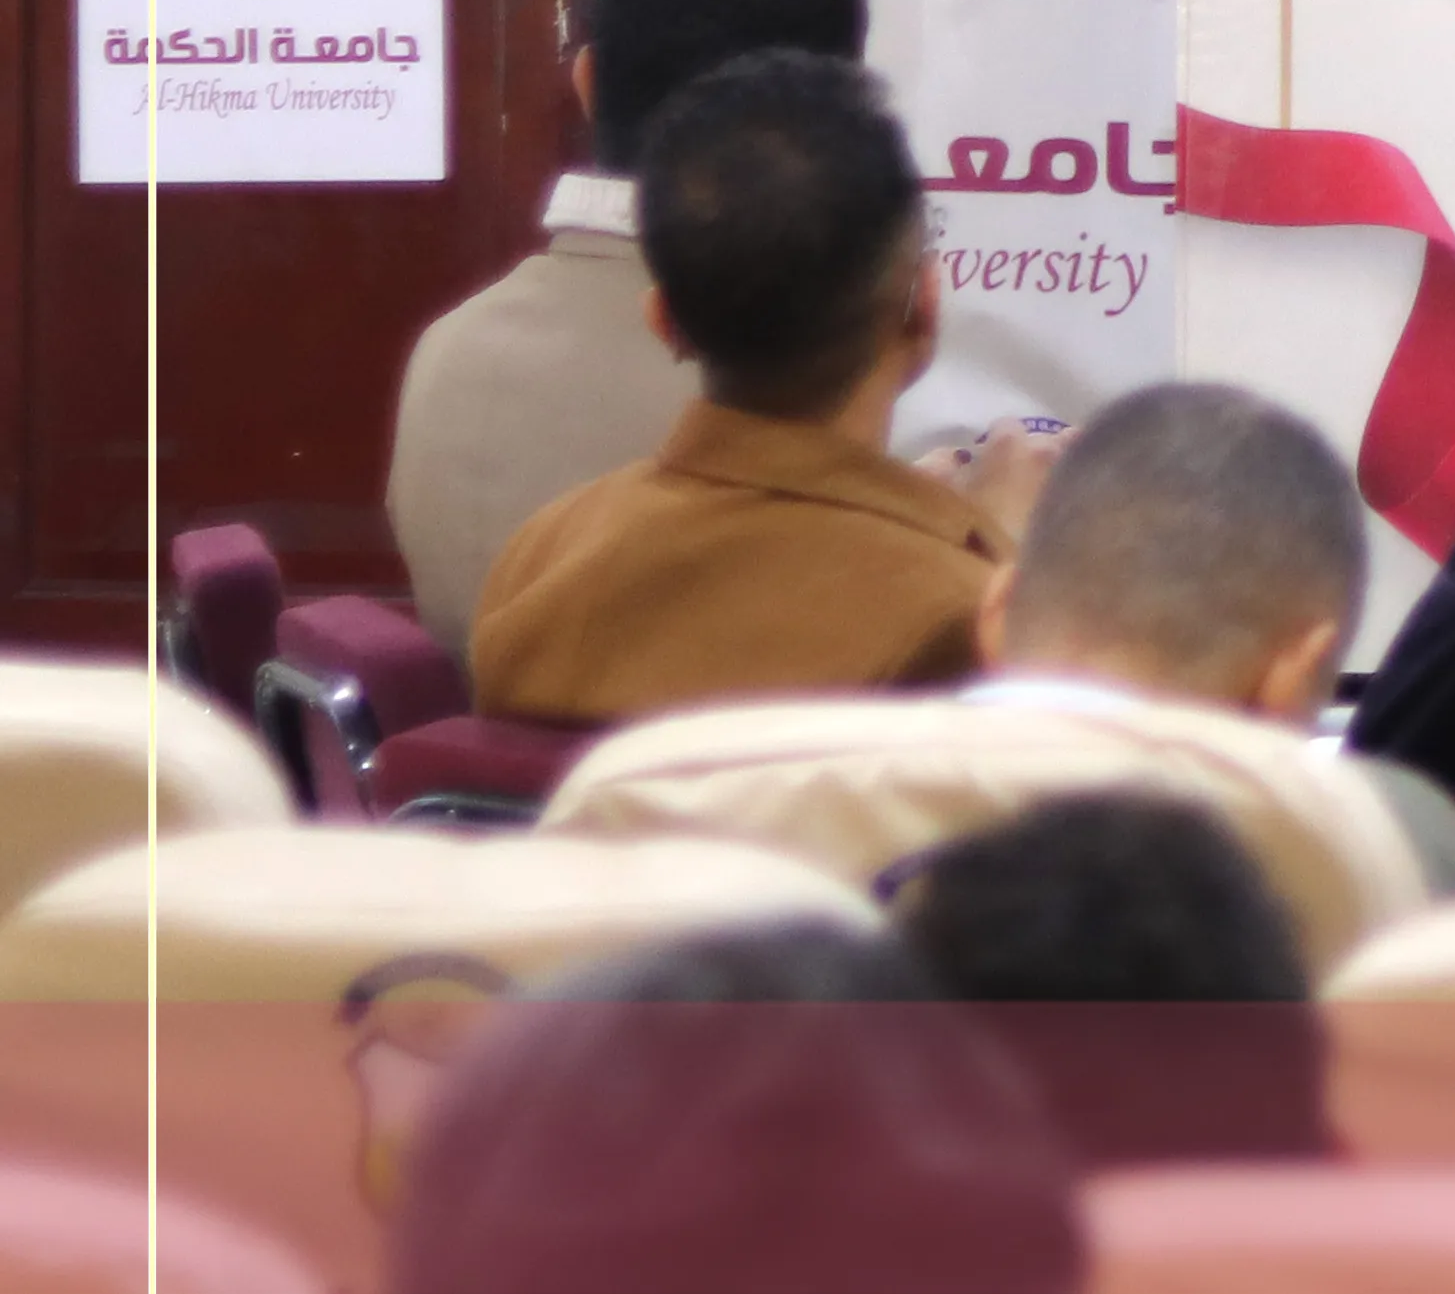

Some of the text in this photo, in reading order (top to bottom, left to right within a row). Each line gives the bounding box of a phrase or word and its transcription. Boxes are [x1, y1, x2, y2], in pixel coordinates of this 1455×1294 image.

[103, 26, 421, 73] جامعة الحكمة
[132, 78, 396, 121] Al-Hikma University
